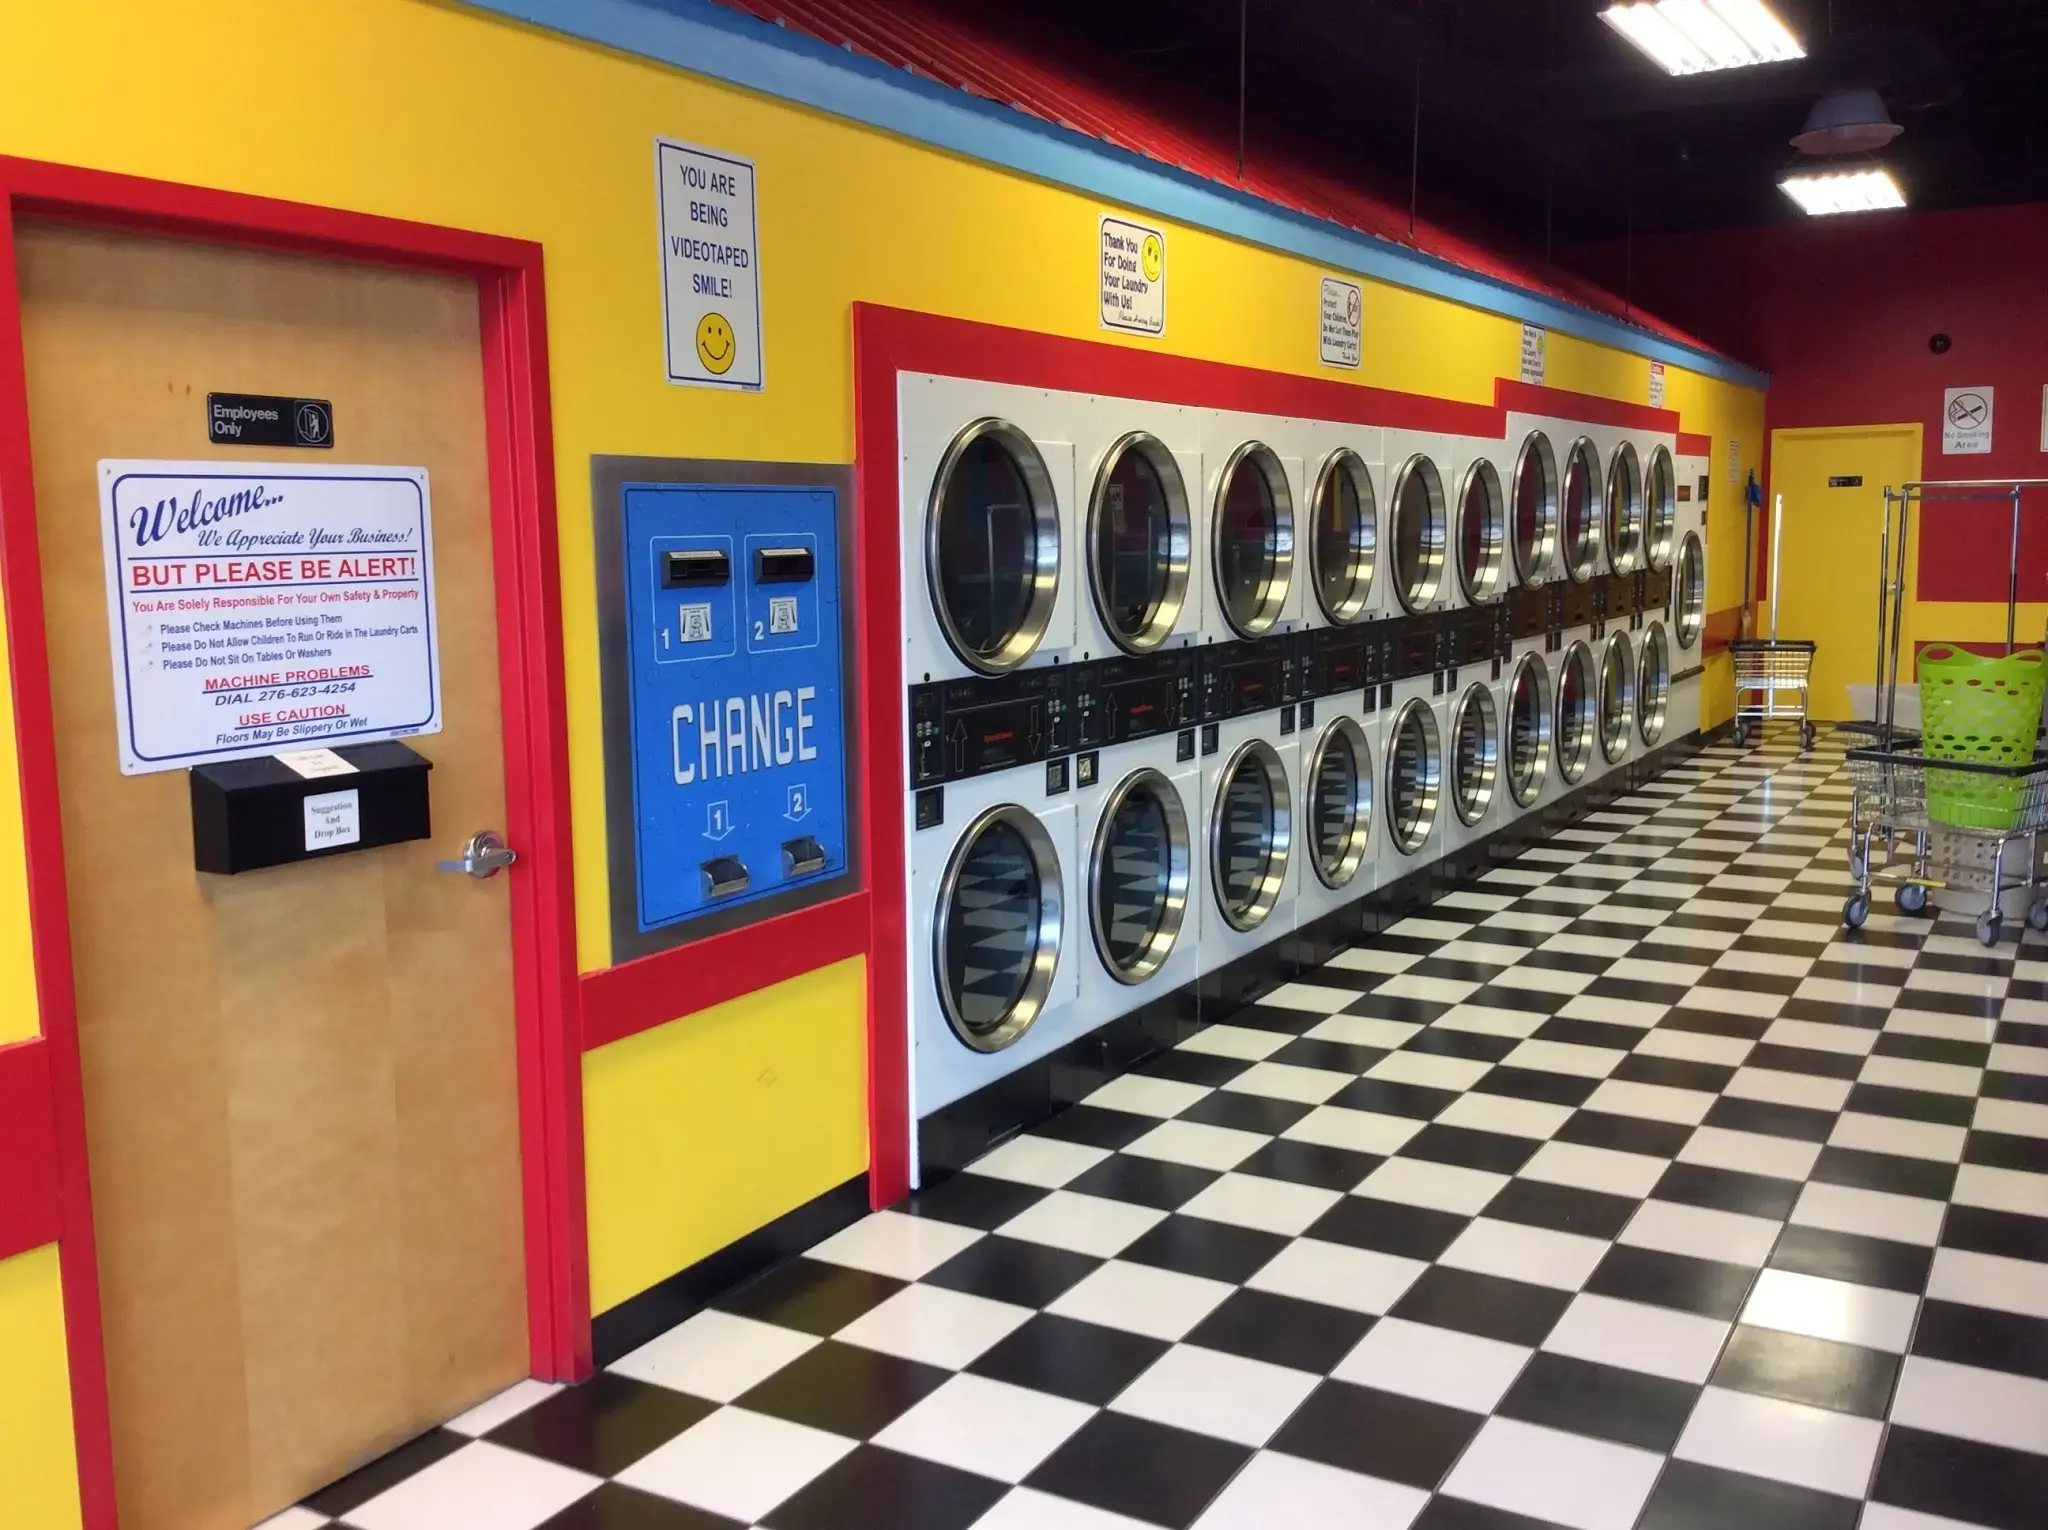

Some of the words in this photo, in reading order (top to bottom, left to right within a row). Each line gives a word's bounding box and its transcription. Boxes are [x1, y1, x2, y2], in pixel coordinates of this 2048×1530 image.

[680, 164, 706, 190] YOU
[710, 172, 736, 197] ARE
[690, 201, 728, 228] BEING
[671, 235, 749, 269] VIDEOTAPED
[1104, 232, 1125, 250] Thank
[1126, 237, 1138, 254] You
[1104, 252, 1116, 268] For
[1118, 255, 1137, 273] Doing
[692, 273, 732, 298] SMILE!
[1104, 271, 1120, 288] Your
[1122, 275, 1149, 294] Laundry
[1104, 291, 1119, 307] With
[1121, 295, 1132, 310] Us!
[214, 404, 279, 422] Employees
[214, 421, 242, 437] Only
[1945, 431, 1954, 439] No
[1956, 431, 1989, 440] Smoking
[1955, 441, 1979, 449] Area
[129, 485, 284, 547] Welcome...
[198, 529, 222, 547] We
[225, 528, 305, 551] Appreciate
[308, 527, 344, 550] Your
[346, 527, 413, 544] Business!
[132, 564, 187, 587] BUT
[195, 560, 293, 584] PLEASE
[300, 559, 332, 580] BE
[338, 557, 416, 578] ALERT!
[133, 601, 154, 613] You
[156, 600, 176, 611] Are
[178, 597, 211, 612] Solely
[213, 595, 276, 610] Responsible
[277, 593, 294, 605] For
[296, 592, 319, 604] Your
[320, 592, 341, 603] Own
[343, 590, 371, 603] Safety
[373, 589, 381, 600] &
[382, 587, 419, 601] Property
[160, 623, 191, 635] Please
[193, 621, 221, 633] Check
[223, 618, 264, 631] Machines
[265, 616, 294, 628] Before
[295, 614, 320, 627] Using
[320, 613, 343, 624] Them
[754, 621, 765, 641] 2
[161, 641, 192, 653] Please
[194, 639, 208, 651] Do
[209, 637, 225, 649] Not
[226, 636, 249, 648] Allow
[251, 633, 285, 645] Children
[286, 632, 297, 643] To
[298, 631, 314, 642] Run
[315, 630, 326, 641] Or
[327, 629, 344, 641] Ride
[345, 629, 353, 639] In
[354, 627, 368, 639] The
[369, 625, 399, 638] Laundry
[400, 624, 419, 635] Carts
[660, 628, 670, 650] 1
[162, 659, 193, 671] Please
[195, 656, 208, 668] Do
[210, 655, 226, 667] Not
[227, 653, 240, 666] Sit
[241, 652, 255, 664] On
[256, 650, 284, 663] Tables
[285, 649, 296, 661] Or
[297, 647, 332, 659] Washers
[205, 672, 281, 691] MACHINE
[285, 664, 371, 683] PROBLEMS
[215, 693, 253, 706] DIAL
[257, 682, 357, 702] 276-623-4254
[239, 711, 272, 726] USE
[276, 703, 346, 722] CAUTION
[216, 732, 250, 745] Floors
[252, 729, 274, 741] May
[276, 726, 290, 738] Be
[292, 722, 333, 736] Slippery
[335, 719, 348, 731] Or
[350, 717, 368, 728] Wet
[672, 686, 817, 786] CHANGE
[311, 801, 353, 816] Suggestion
[793, 793, 803, 812] 2
[324, 815, 341, 825] And
[713, 809, 722, 831] 1
[314, 829, 335, 840] Drop
[336, 826, 351, 835] Box
